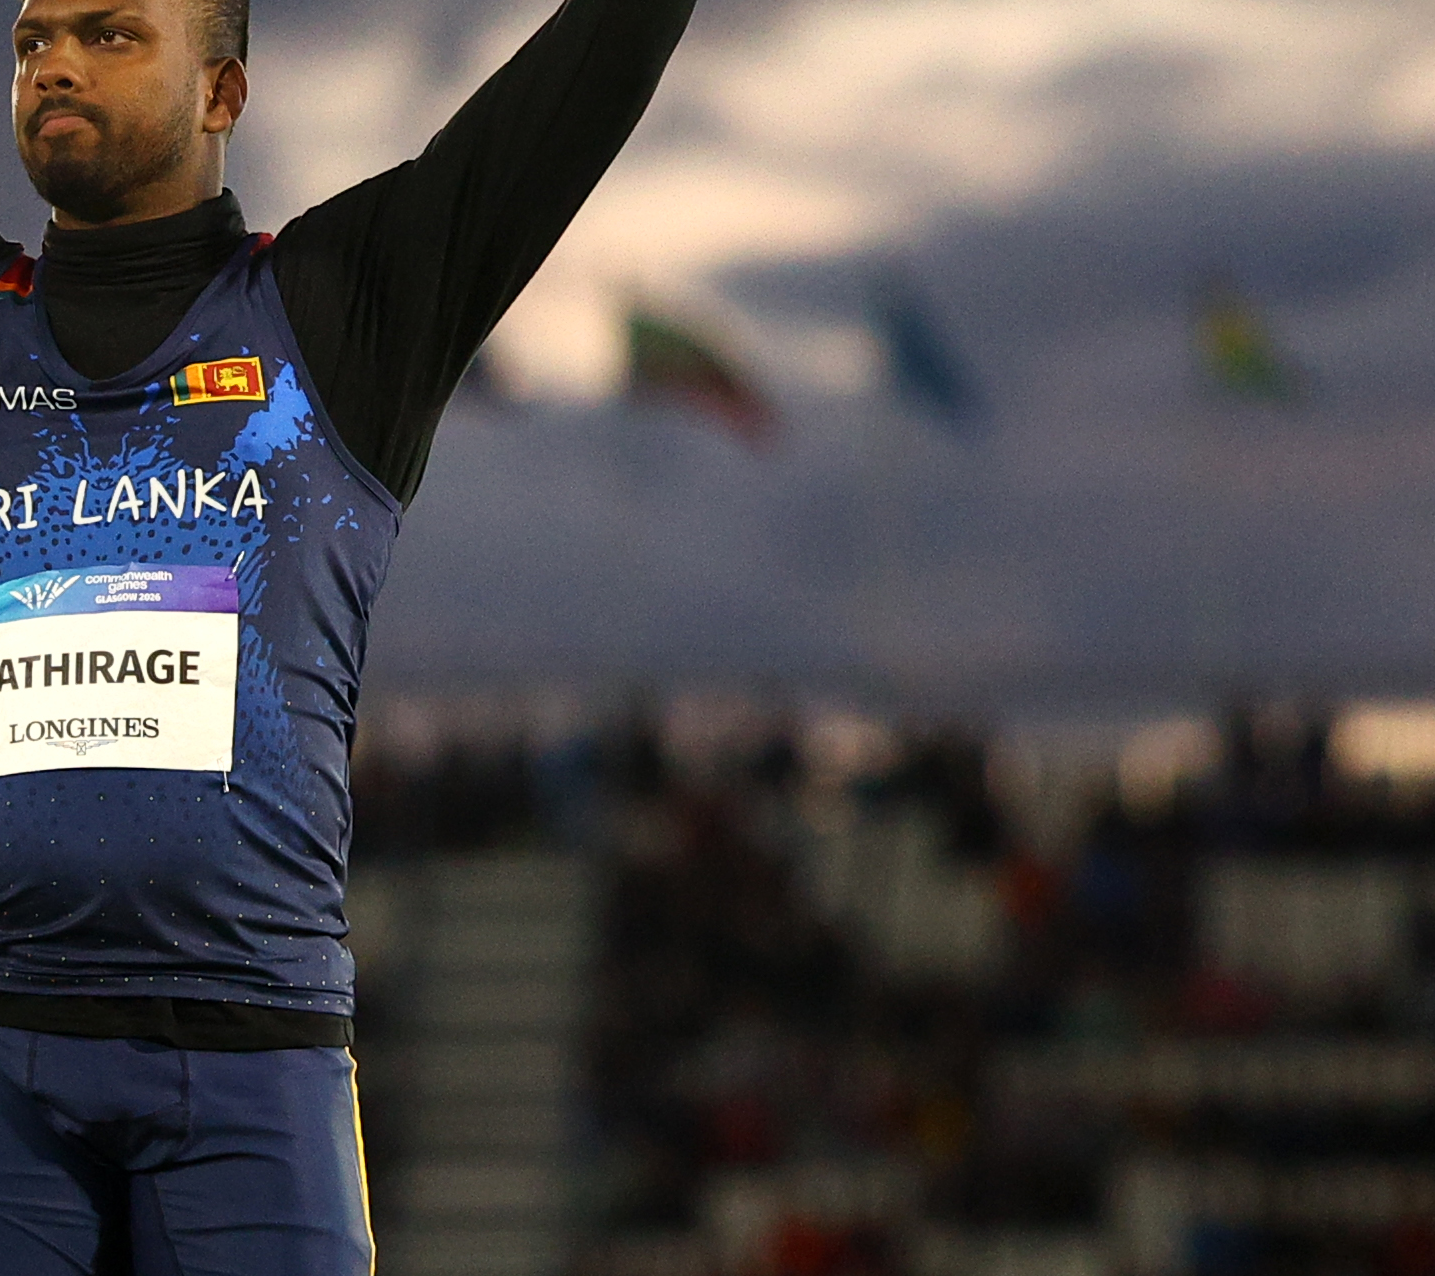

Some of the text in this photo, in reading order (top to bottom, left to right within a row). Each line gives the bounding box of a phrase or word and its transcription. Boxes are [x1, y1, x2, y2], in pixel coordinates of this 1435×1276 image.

[72, 468, 268, 525] LANKA
[85, 571, 173, 584] commonwealth
[108, 581, 147, 594] games
[95, 593, 161, 604] GLASGOW 2026
[9, 717, 160, 744] LONGINES
